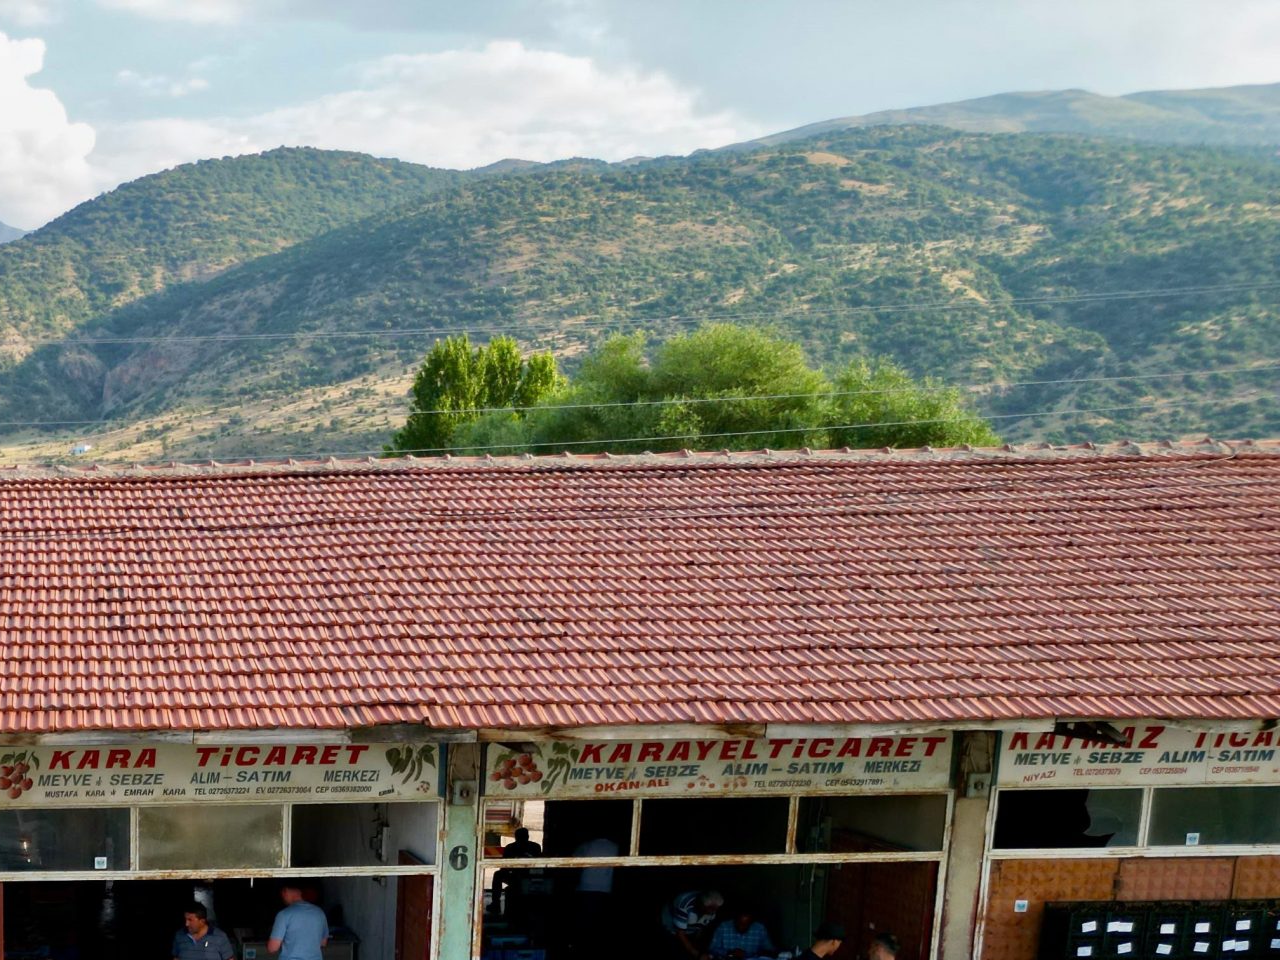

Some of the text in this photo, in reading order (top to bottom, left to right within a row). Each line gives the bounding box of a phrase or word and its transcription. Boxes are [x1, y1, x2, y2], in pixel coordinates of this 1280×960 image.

[48, 748, 156, 770] KARA
[578, 740, 758, 764] KARAYEL
[1014, 752, 1072, 765] MEYVE
[1088, 752, 1144, 763] SEBZE
[1157, 750, 1205, 763] ALIM
[1217, 749, 1275, 762] SATIM
[38, 774, 92, 787] MEYVE
[109, 773, 165, 786] SEBZE
[190, 772, 220, 784] ALIM
[236, 770, 291, 782] SATIM
[569, 767, 625, 780] MEYVE
[644, 764, 701, 778] SEBZE
[721, 763, 768, 776] ALIM
[786, 762, 844, 774] SATIM
[162, 788, 186, 796] KARA
[449, 845, 468, 871] 6
